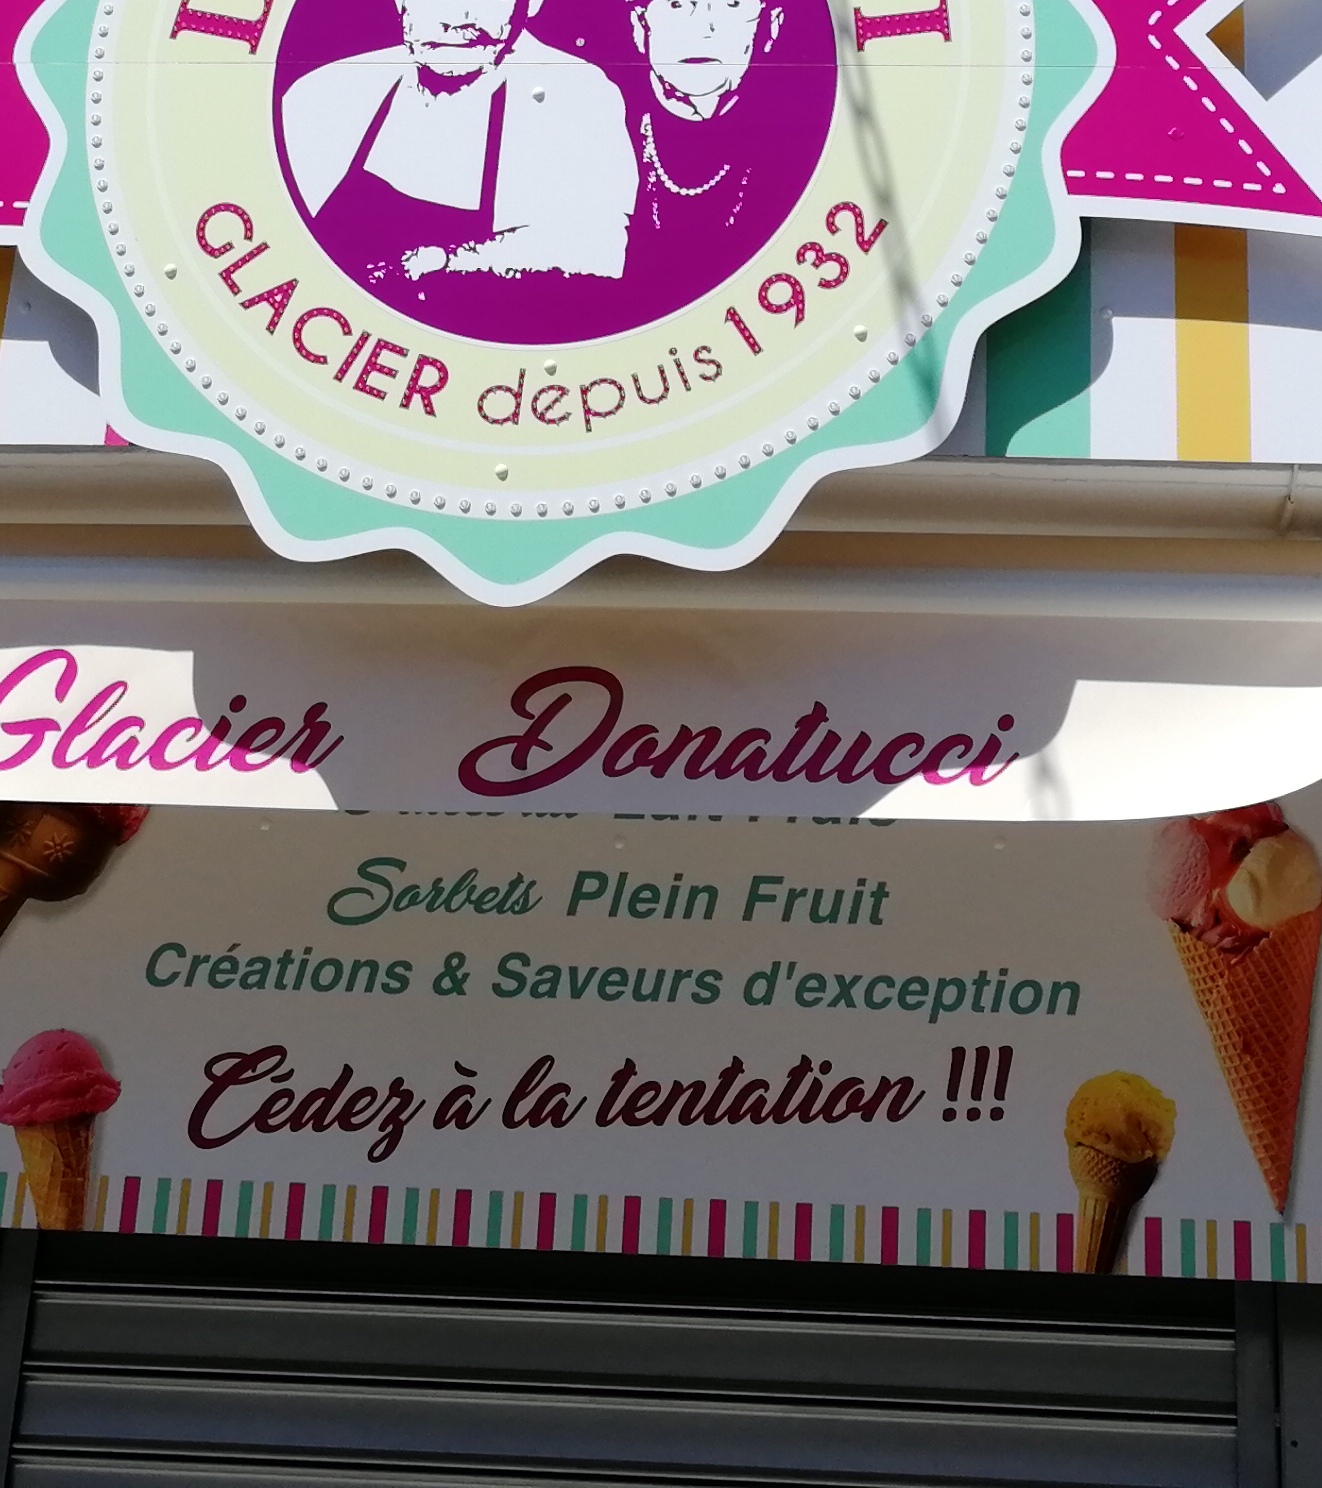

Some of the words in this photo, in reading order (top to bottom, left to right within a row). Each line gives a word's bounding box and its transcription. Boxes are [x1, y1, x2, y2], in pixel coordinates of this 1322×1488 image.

[194, 201, 449, 419] GLACIER
[476, 339, 723, 434] depuis
[723, 200, 889, 357] 1932
[457, 665, 1019, 797] Donatucci
[326, 856, 543, 927] Sorbets
[566, 870, 718, 921] Plein
[742, 874, 890, 927] Fruit
[144, 941, 412, 996] Créations
[432, 953, 469, 997] &
[491, 952, 723, 1007] Saveurs
[741, 960, 1081, 1025] d'exception
[186, 1043, 426, 1164] Cédez
[432, 1059, 491, 1131] à
[501, 1053, 586, 1131] la
[595, 1057, 926, 1131] tentation
[939, 1045, 1014, 1123] !!!
